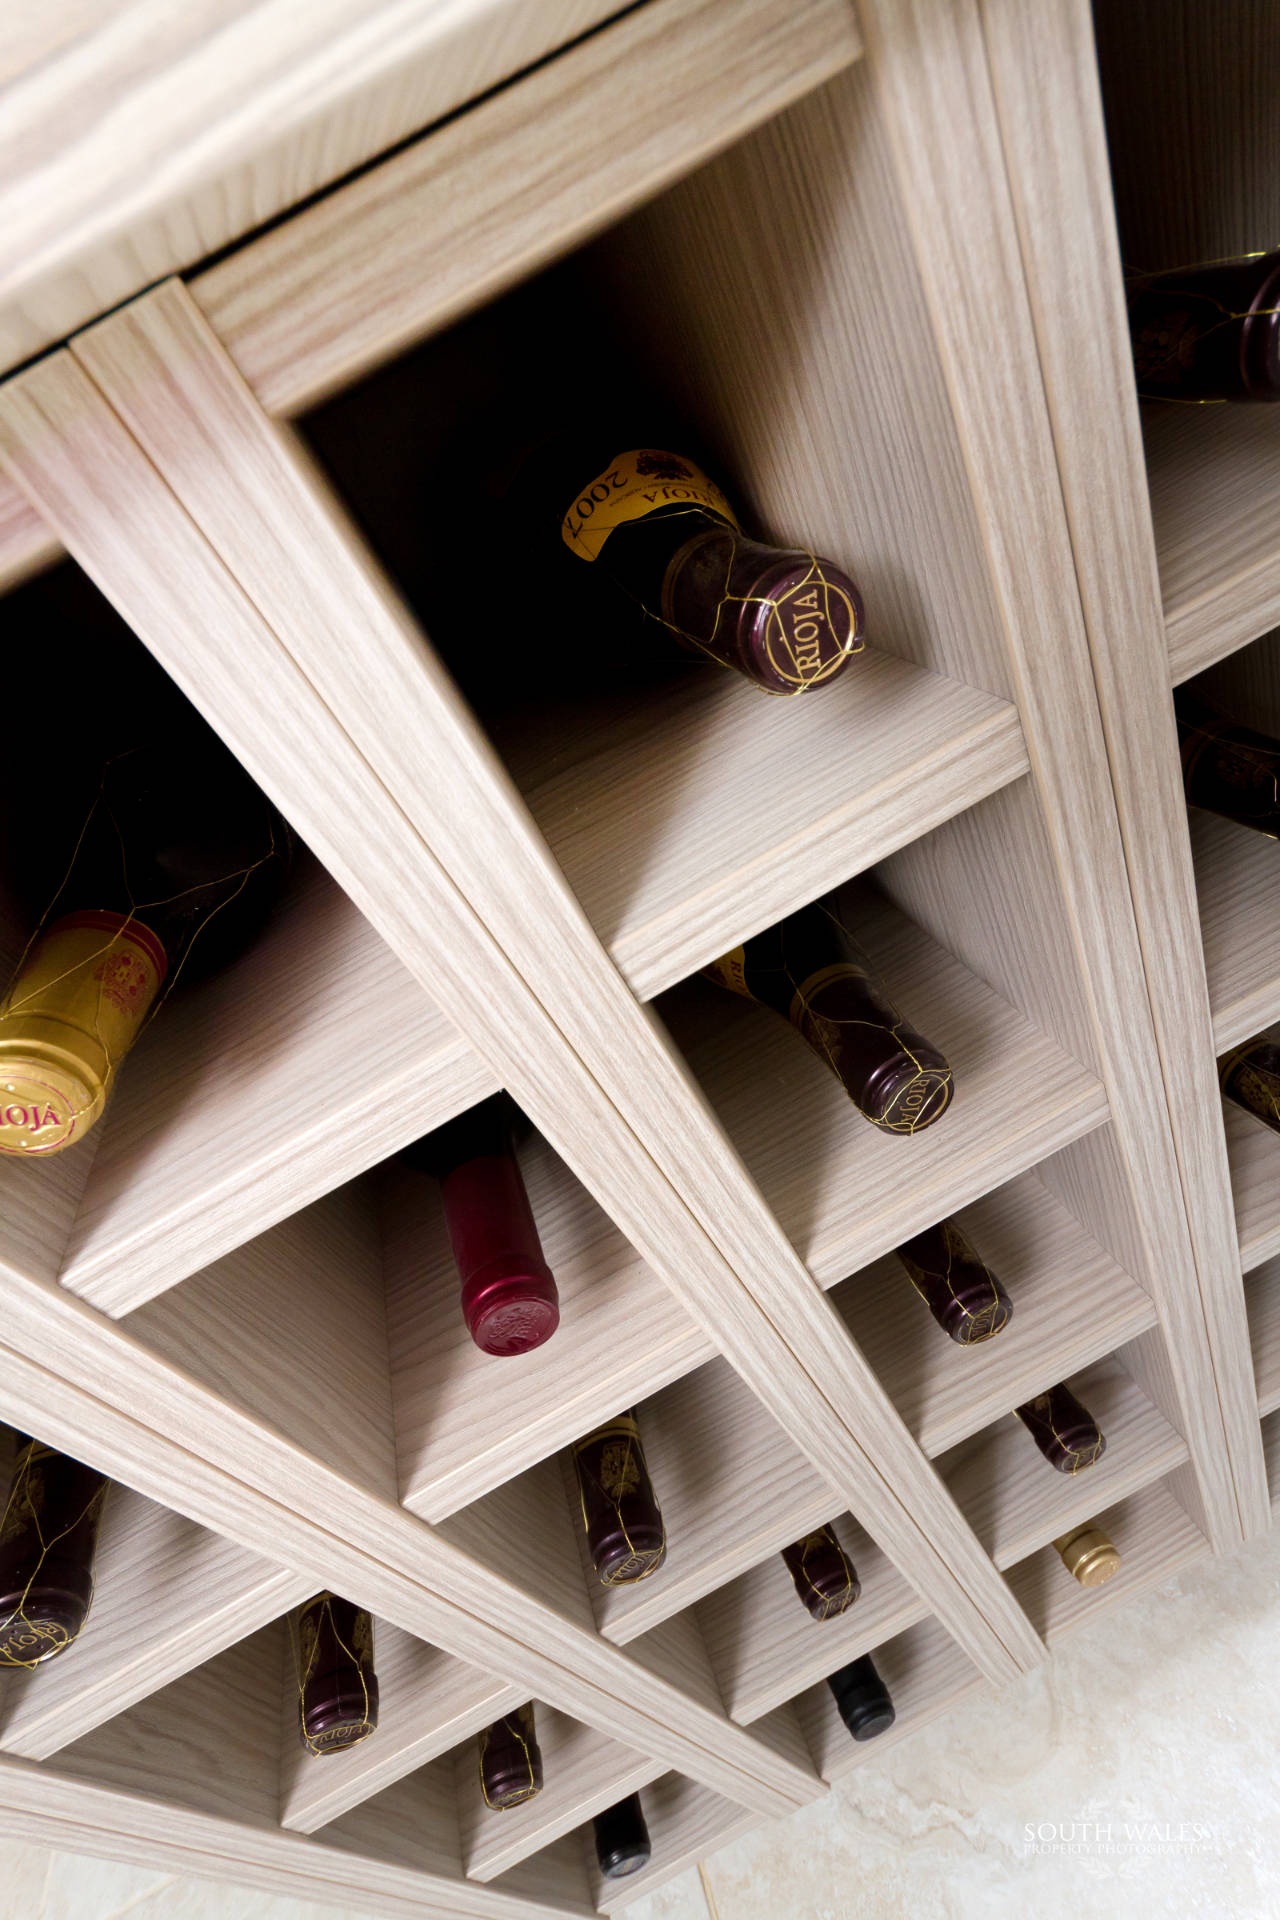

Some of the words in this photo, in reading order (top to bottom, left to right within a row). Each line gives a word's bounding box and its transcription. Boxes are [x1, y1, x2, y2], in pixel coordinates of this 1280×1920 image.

[563, 470, 628, 539] 2007
[791, 588, 824, 675] RIOJA
[899, 1078, 931, 1123] RIOJA
